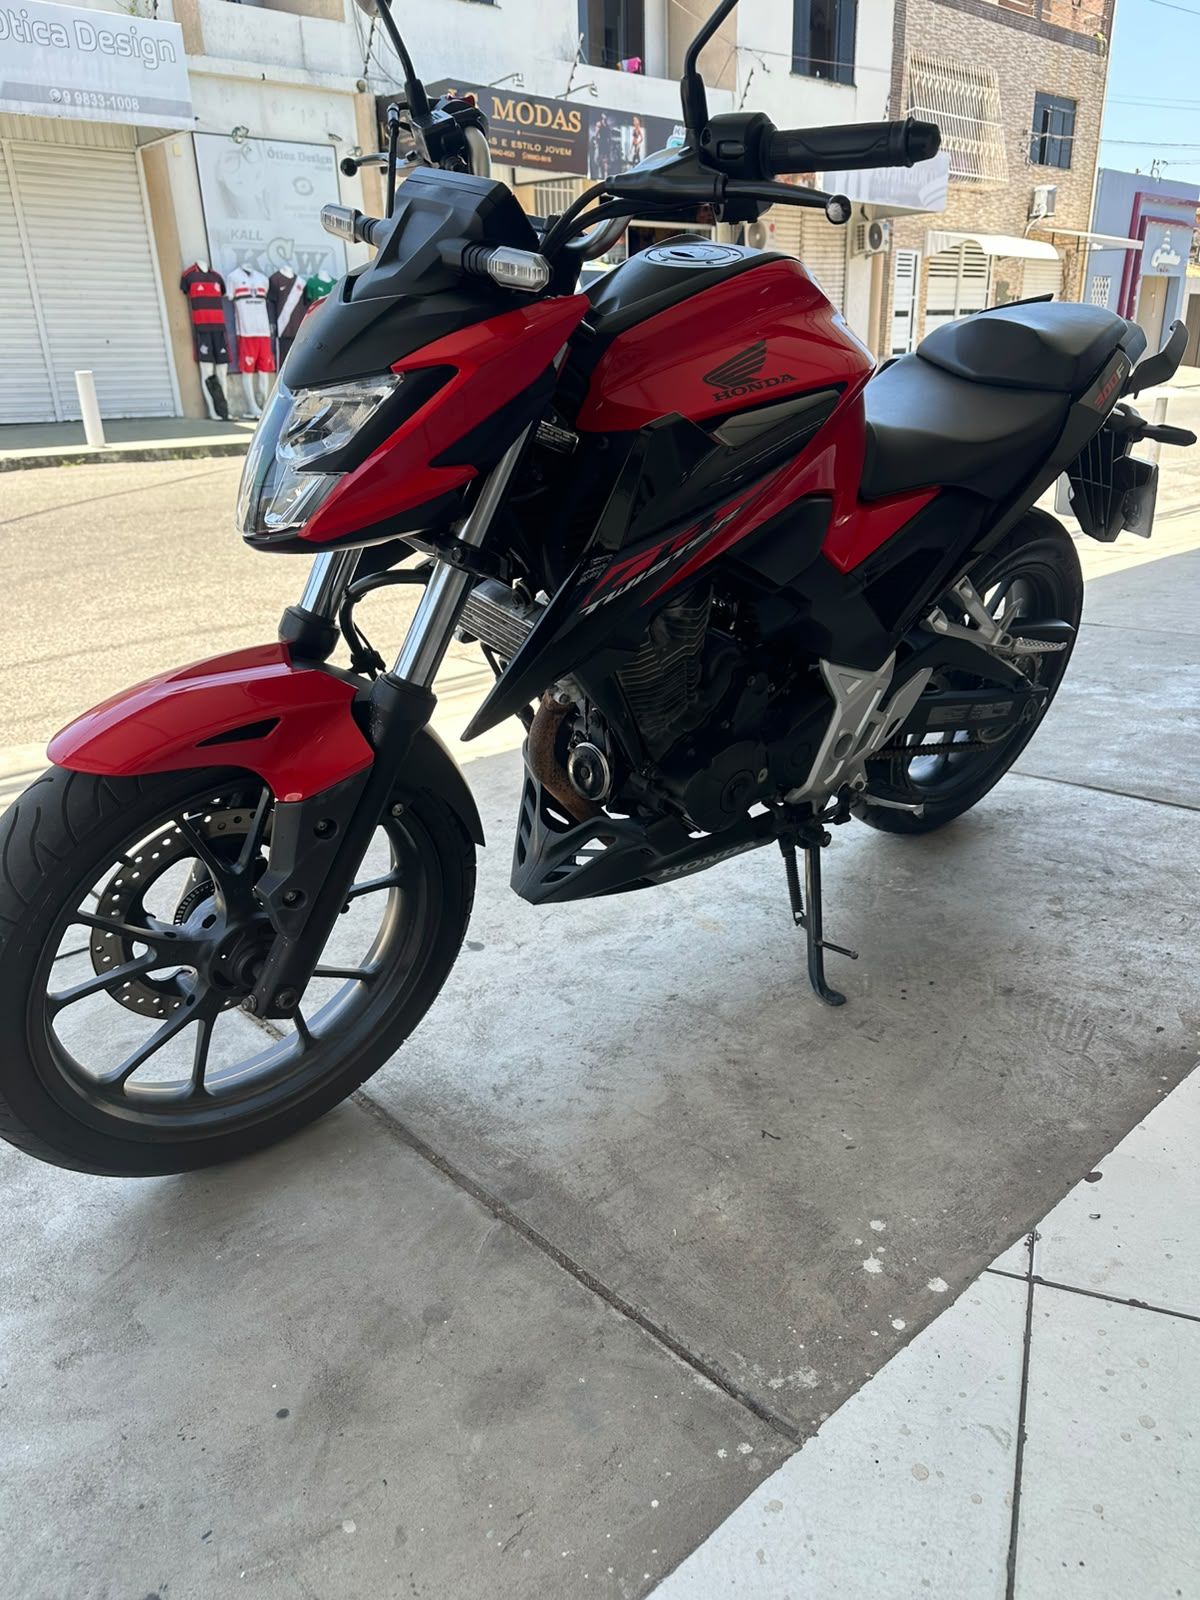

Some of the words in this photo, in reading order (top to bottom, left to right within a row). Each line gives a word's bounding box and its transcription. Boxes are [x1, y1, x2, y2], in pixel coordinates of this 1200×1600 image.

[73, 19, 177, 70] Design
[74, 91, 140, 112] 9833-1008
[491, 95, 582, 134] MODAS
[297, 151, 333, 165] Design
[511, 139, 542, 152] ESTILO
[544, 145, 572, 158] JOVEM
[231, 229, 263, 241] KALL
[712, 372, 799, 402] HONDA
[1094, 361, 1125, 409] 300F
